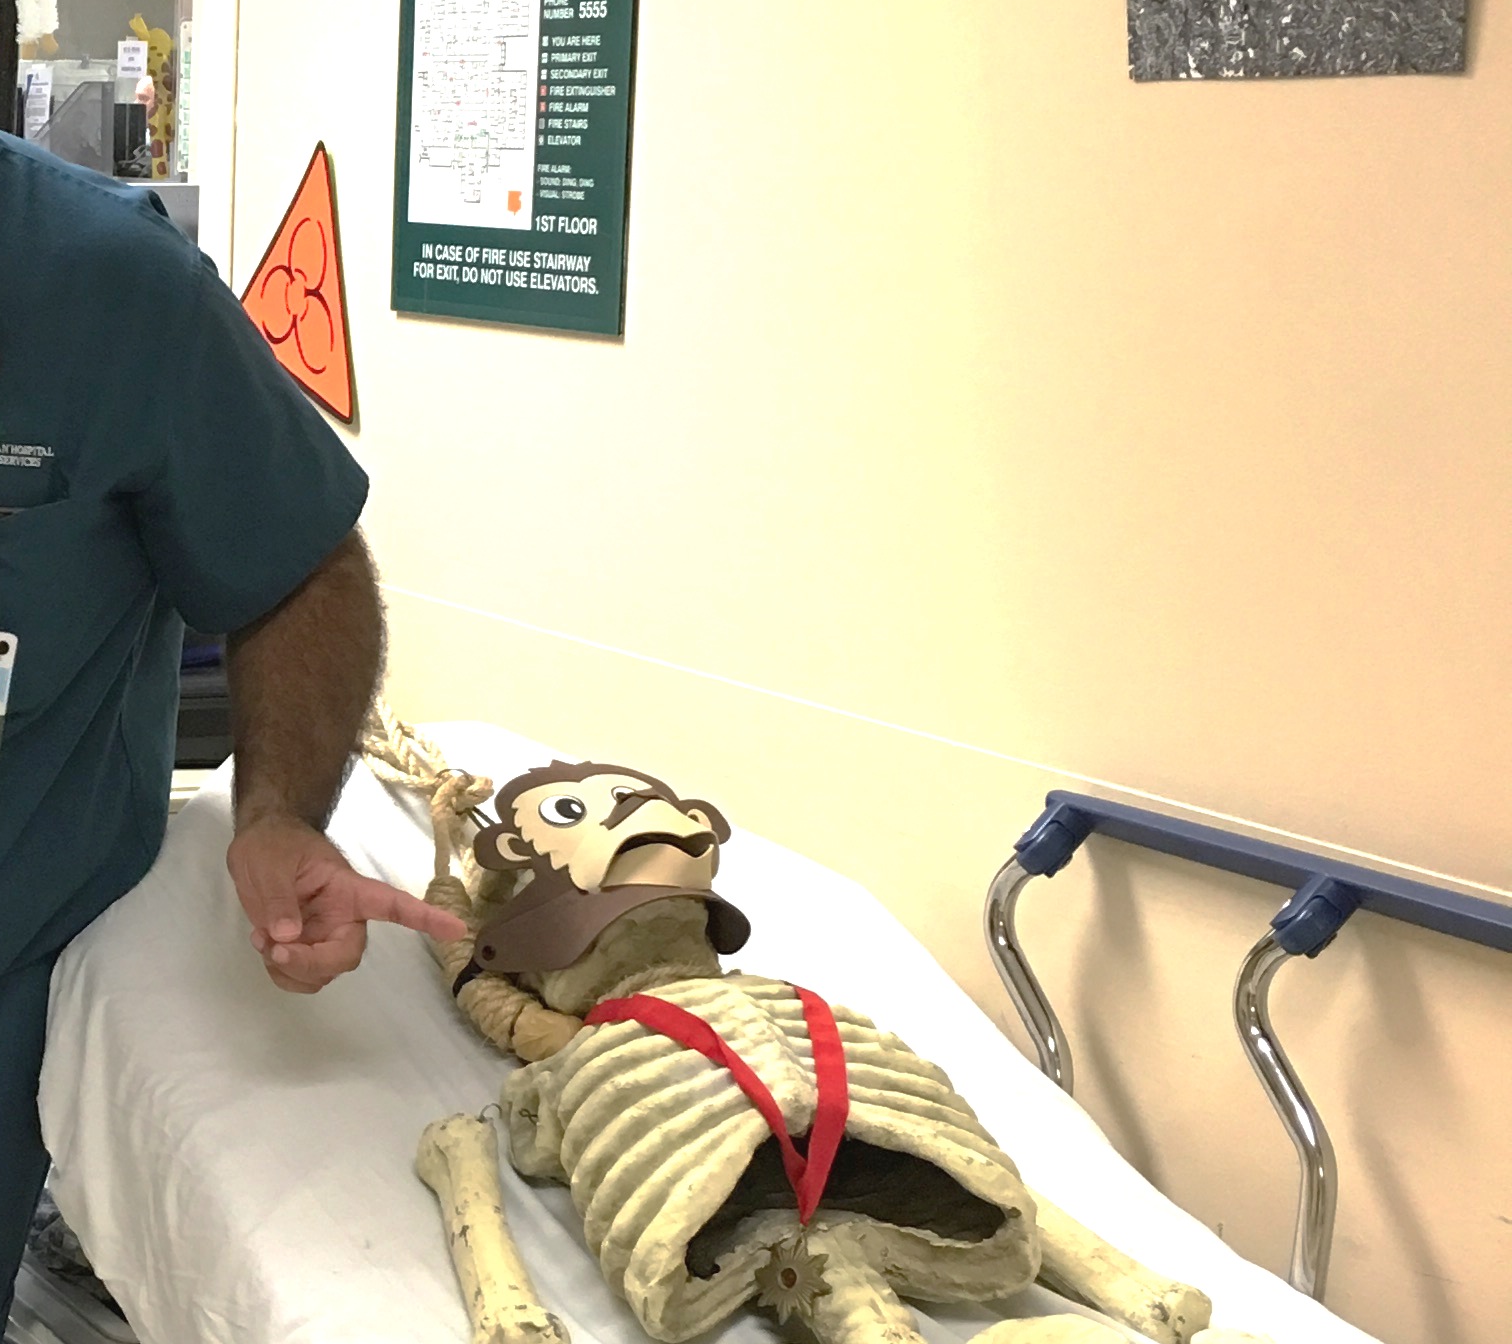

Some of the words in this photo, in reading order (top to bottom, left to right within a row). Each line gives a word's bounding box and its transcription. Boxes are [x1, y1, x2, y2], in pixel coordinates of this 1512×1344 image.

[544, 8, 574, 20] NUMBER
[578, 0, 608, 19] 5555
[552, 36, 566, 46] YOU
[566, 36, 581, 46] ARE
[582, 35, 601, 46] HERE
[550, 52, 581, 62] PRIMARY
[582, 52, 598, 62] EXIT
[550, 68, 592, 80] SECONDARY
[593, 68, 608, 79] EXIT
[550, 85, 565, 96] FIRE
[566, 85, 616, 96] EXTINGUISHER
[548, 102, 564, 112] FIRE
[564, 102, 589, 112] ALARM
[548, 118, 563, 129] FIRE
[564, 119, 588, 129] STAIRS
[547, 135, 581, 146] ELEVATOR
[535, 215, 556, 232] 1ST
[558, 216, 598, 235] FLOOR
[422, 244, 432, 259] IN
[435, 244, 463, 261] CASE
[465, 246, 480, 263] OF
[482, 248, 507, 266] FIRE
[509, 250, 531, 267] USE
[533, 252, 592, 272] STAIRWAY
[413, 262, 434, 278] FOR
[436, 264, 460, 284] EXIT,
[462, 266, 478, 283] DO
[480, 268, 503, 286] NOT
[505, 271, 528, 288] USE
[530, 274, 600, 295] ELEVATORS.
[10, 444, 55, 457] HOSPITAL
